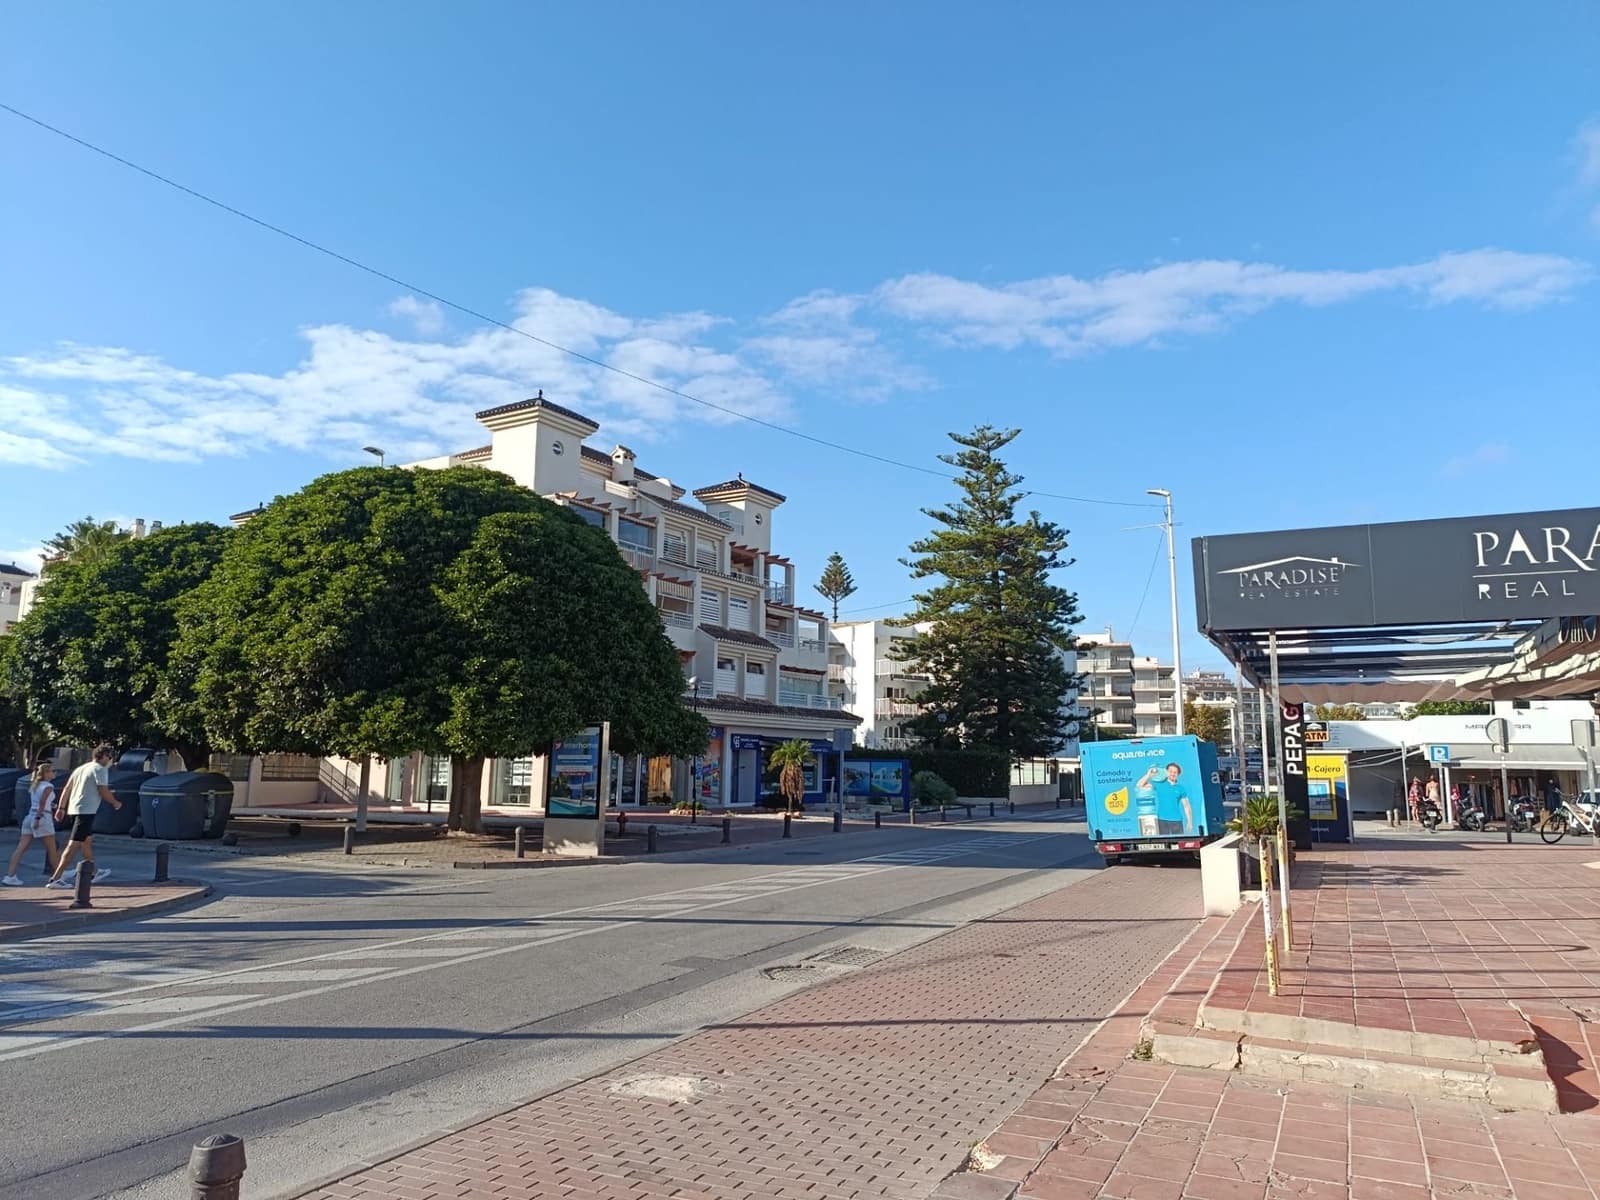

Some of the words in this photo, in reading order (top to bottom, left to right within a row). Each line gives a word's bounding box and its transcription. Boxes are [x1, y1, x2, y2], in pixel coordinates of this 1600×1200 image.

[1239, 567, 1341, 589] PARADISE
[1478, 579, 1576, 600] REAL
[1434, 747, 1447, 760] P
